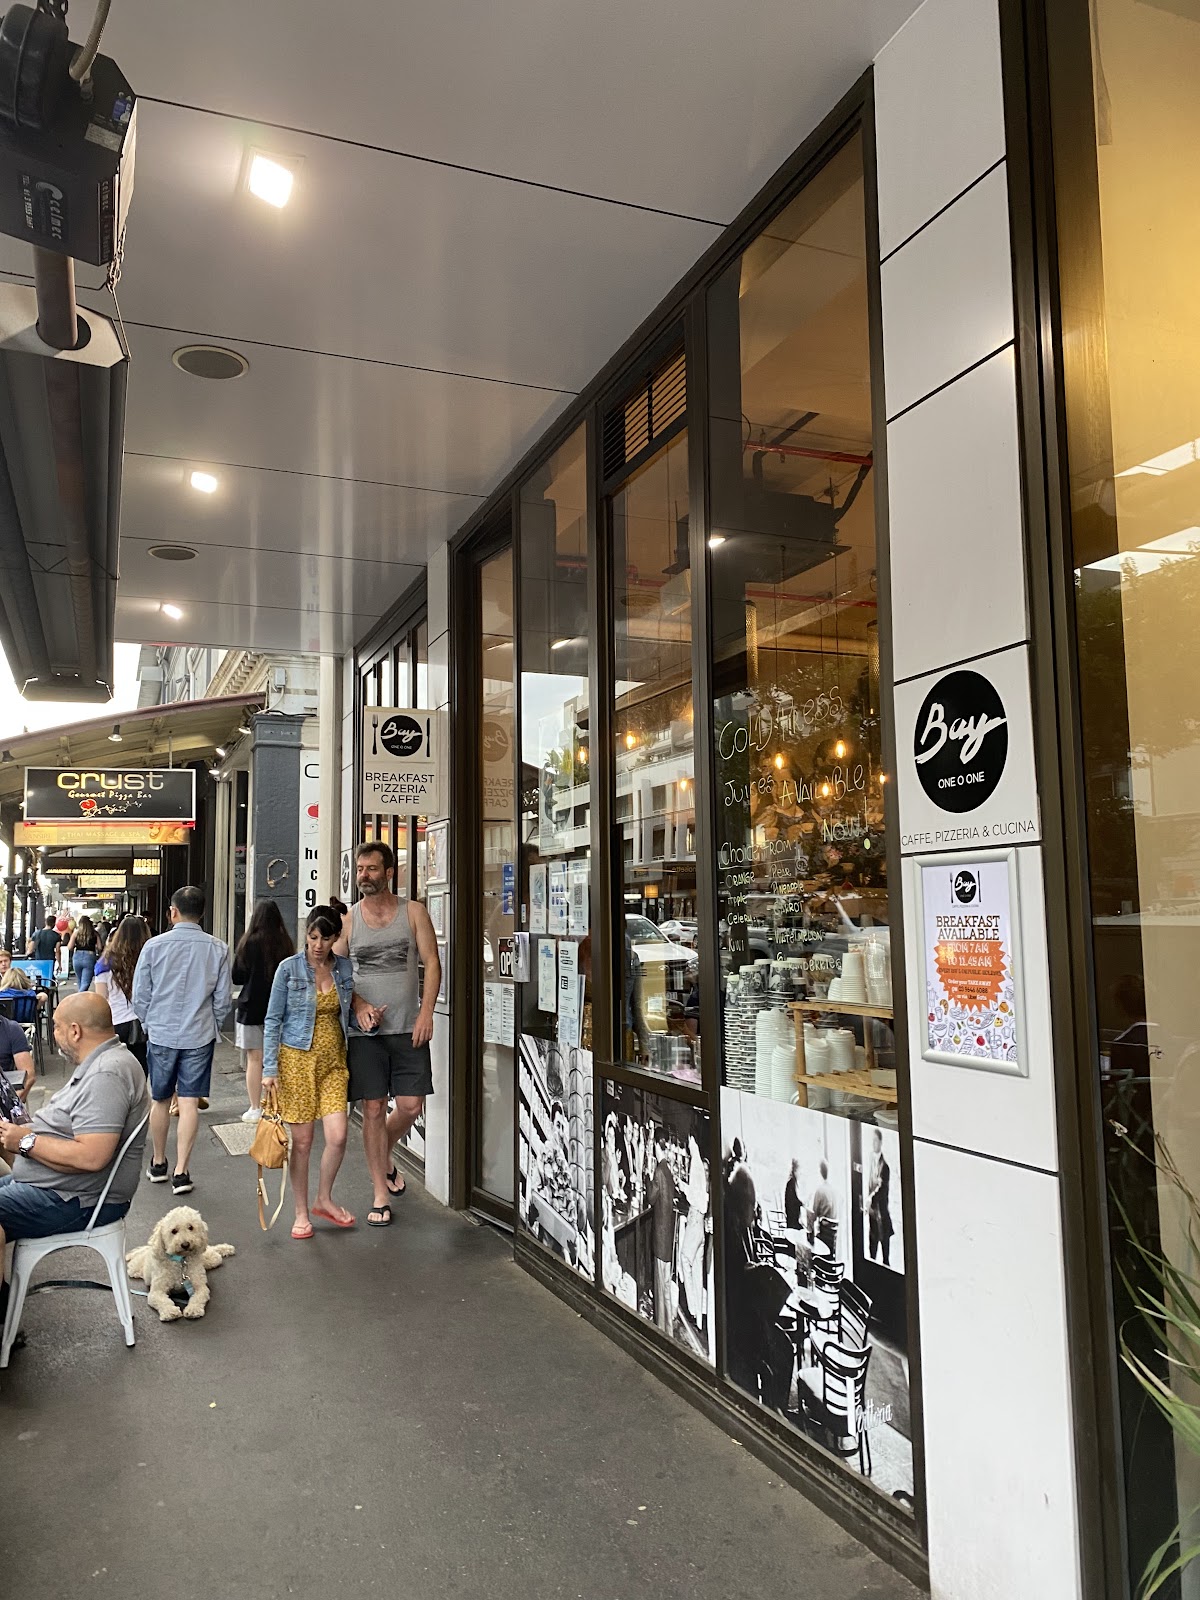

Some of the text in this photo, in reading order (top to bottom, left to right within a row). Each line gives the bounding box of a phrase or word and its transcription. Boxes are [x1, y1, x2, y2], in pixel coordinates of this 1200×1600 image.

[381, 721, 423, 743] Bay
[914, 702, 1008, 764] Bay
[57, 771, 164, 790] crust
[365, 772, 435, 783] BREAKFAST
[938, 771, 985, 789] ONE O ONE
[373, 783, 427, 794] PIZZERIA
[381, 794, 420, 804] CAFFE
[902, 820, 1036, 846] CAFFE, PIZZERIA & CUCINA
[955, 876, 977, 893] Bay
[936, 915, 1000, 928] BREAKFAST
[937, 928, 1000, 940] AVAILABLE
